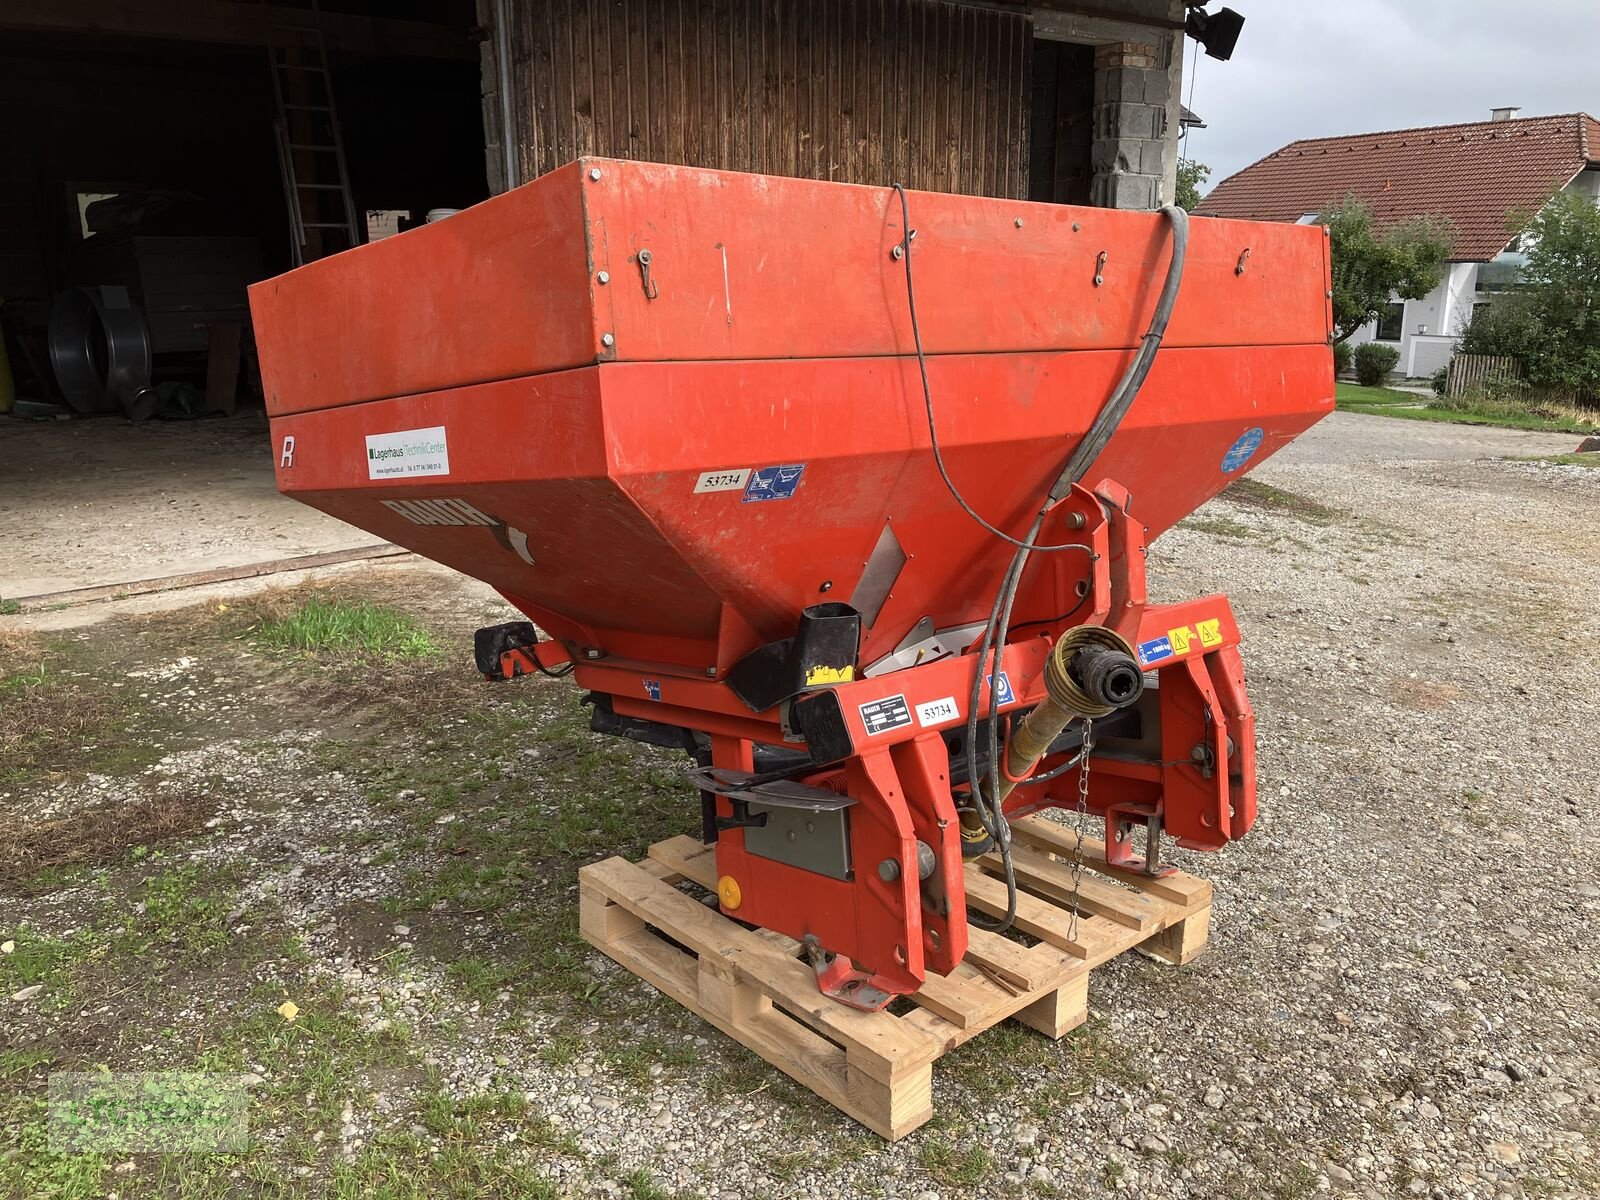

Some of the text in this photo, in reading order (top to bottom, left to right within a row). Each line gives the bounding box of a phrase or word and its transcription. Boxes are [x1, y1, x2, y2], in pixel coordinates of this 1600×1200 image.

[281, 435, 295, 467] R
[374, 442, 446, 461] Lagerhaus TechnikCenter
[704, 474, 741, 488] 53734
[380, 498, 502, 526] RAUCH
[863, 704, 881, 715] RAUCH
[924, 703, 951, 719] 53734
